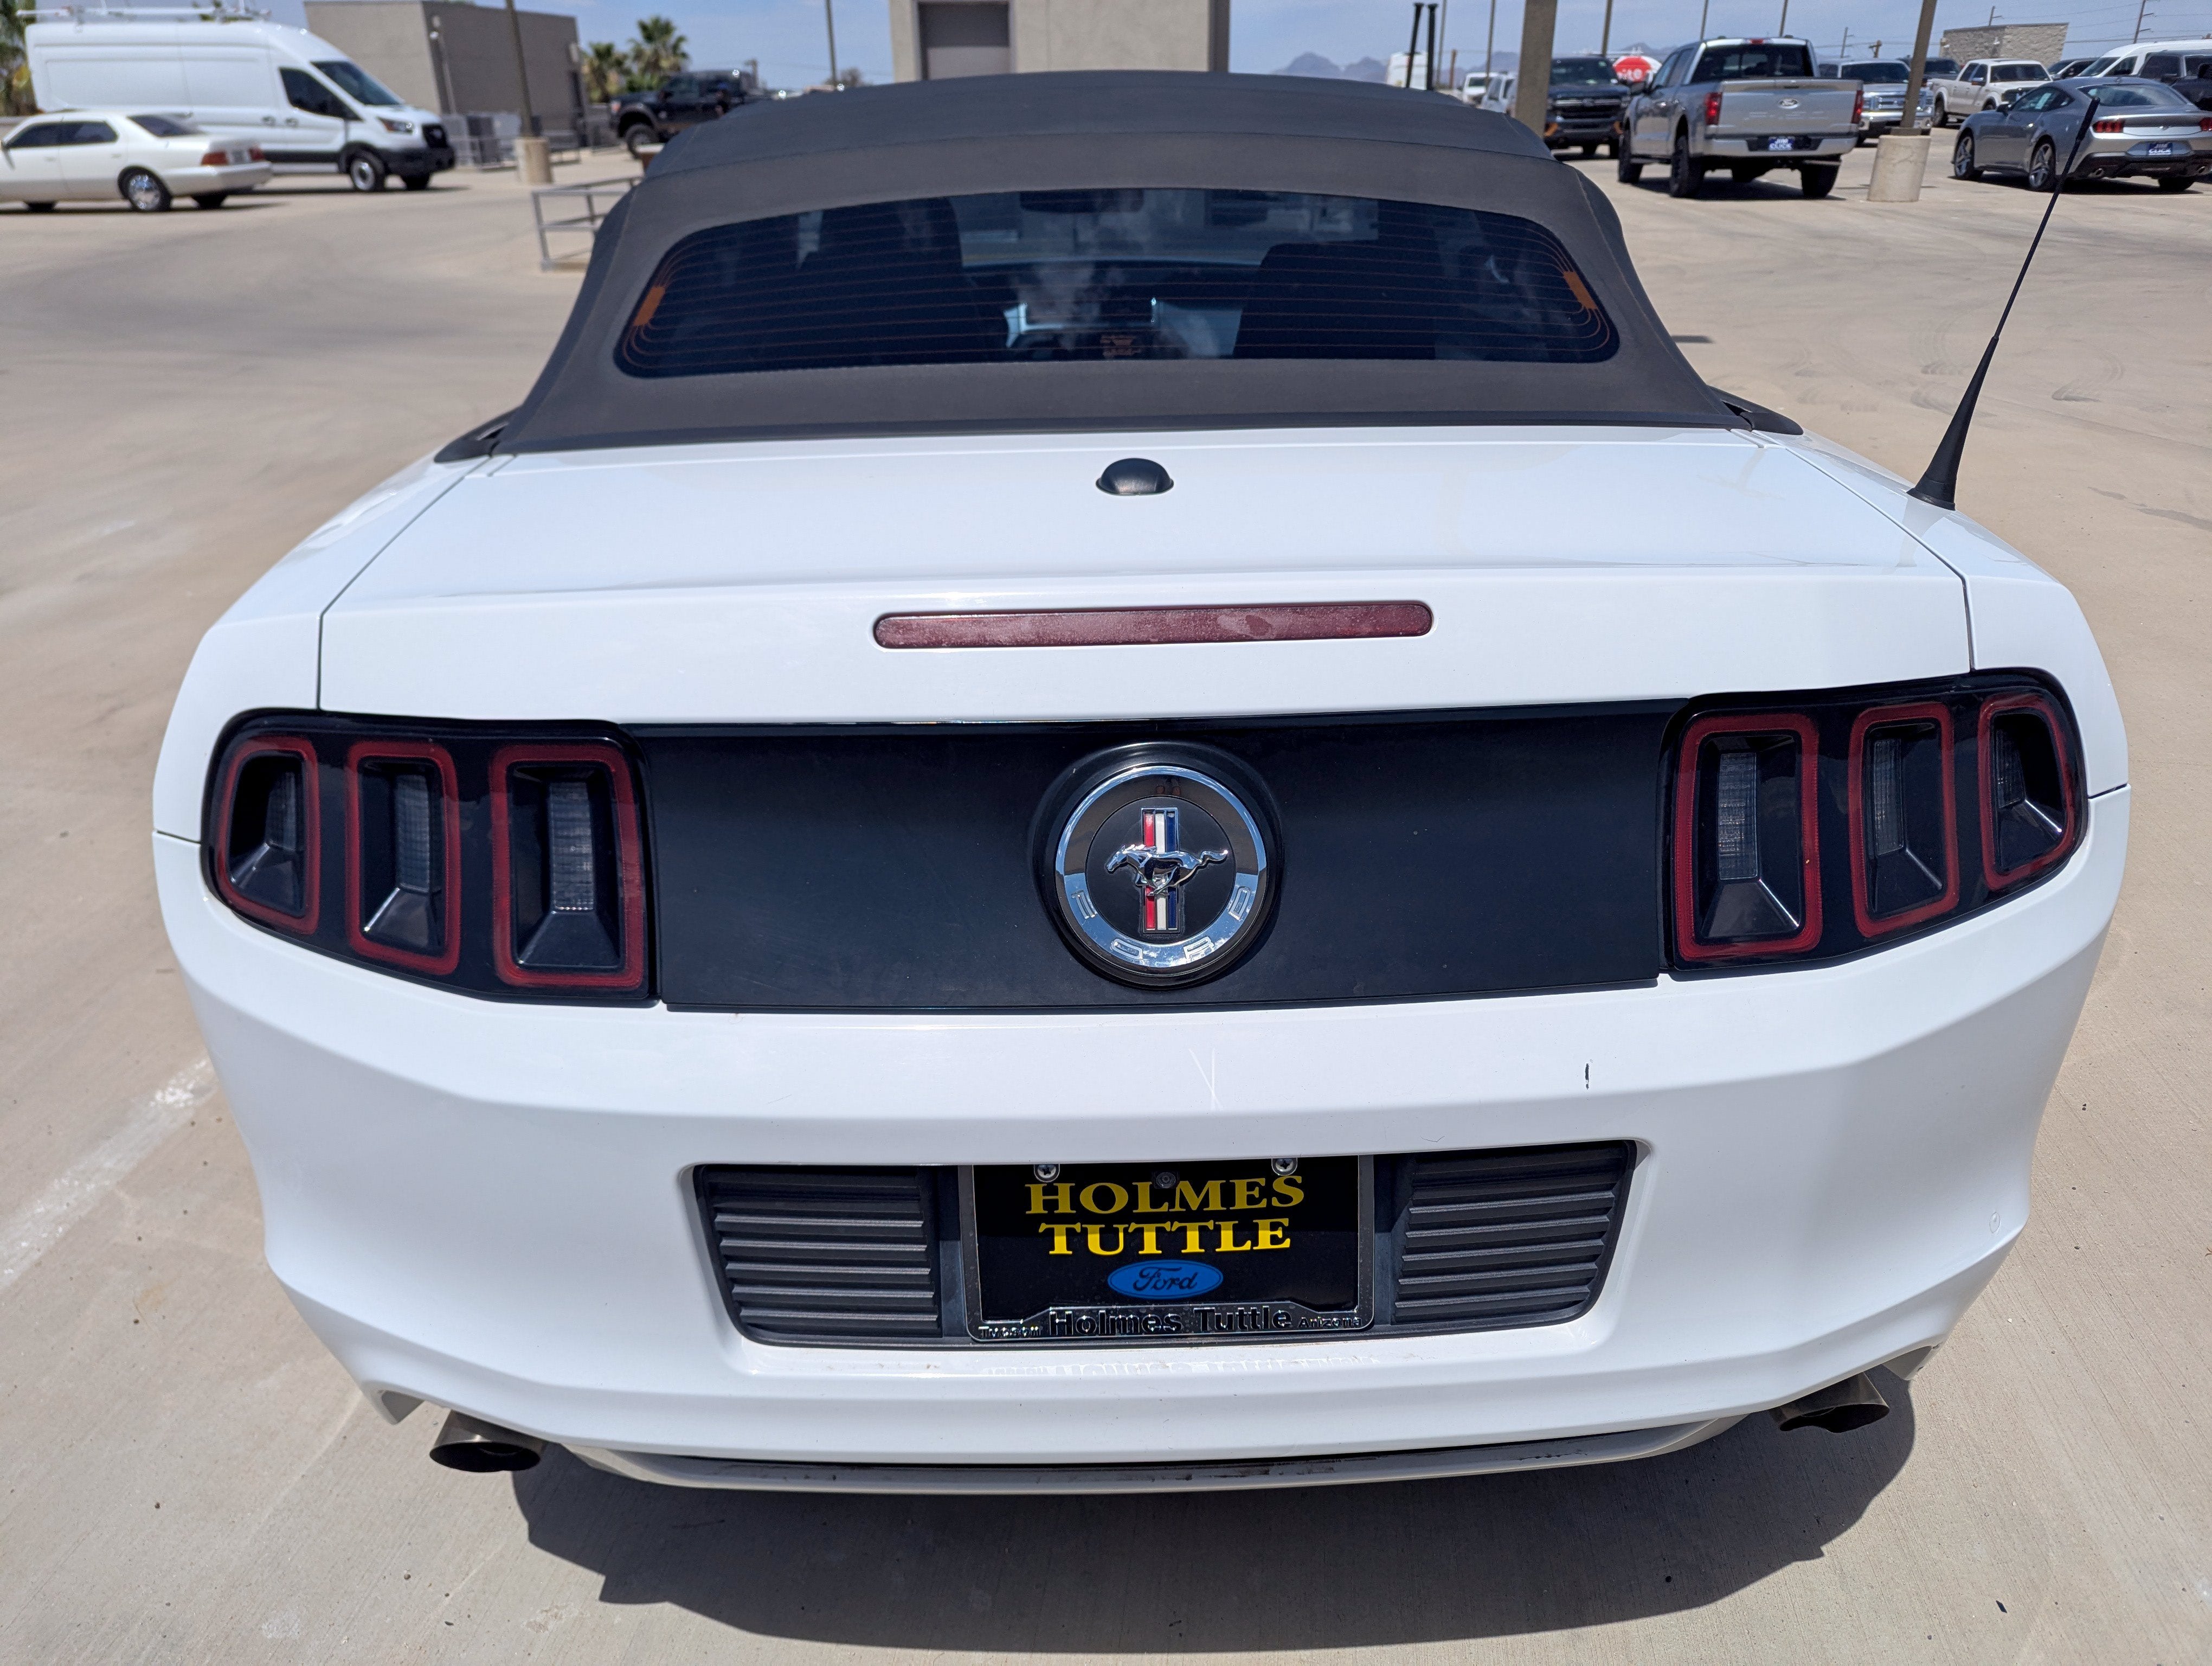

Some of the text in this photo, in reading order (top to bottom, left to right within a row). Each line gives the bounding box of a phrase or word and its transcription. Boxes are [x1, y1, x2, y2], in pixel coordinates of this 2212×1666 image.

[1025, 1175, 1304, 1214] HOLMES
[1038, 1218, 1291, 1255] TUTTLE
[1132, 1266, 1199, 1292] Ford
[1049, 1310, 1183, 1336] Holmes
[1193, 1305, 1293, 1331] Tuttle
[1297, 1316, 1363, 1329] Arizona
